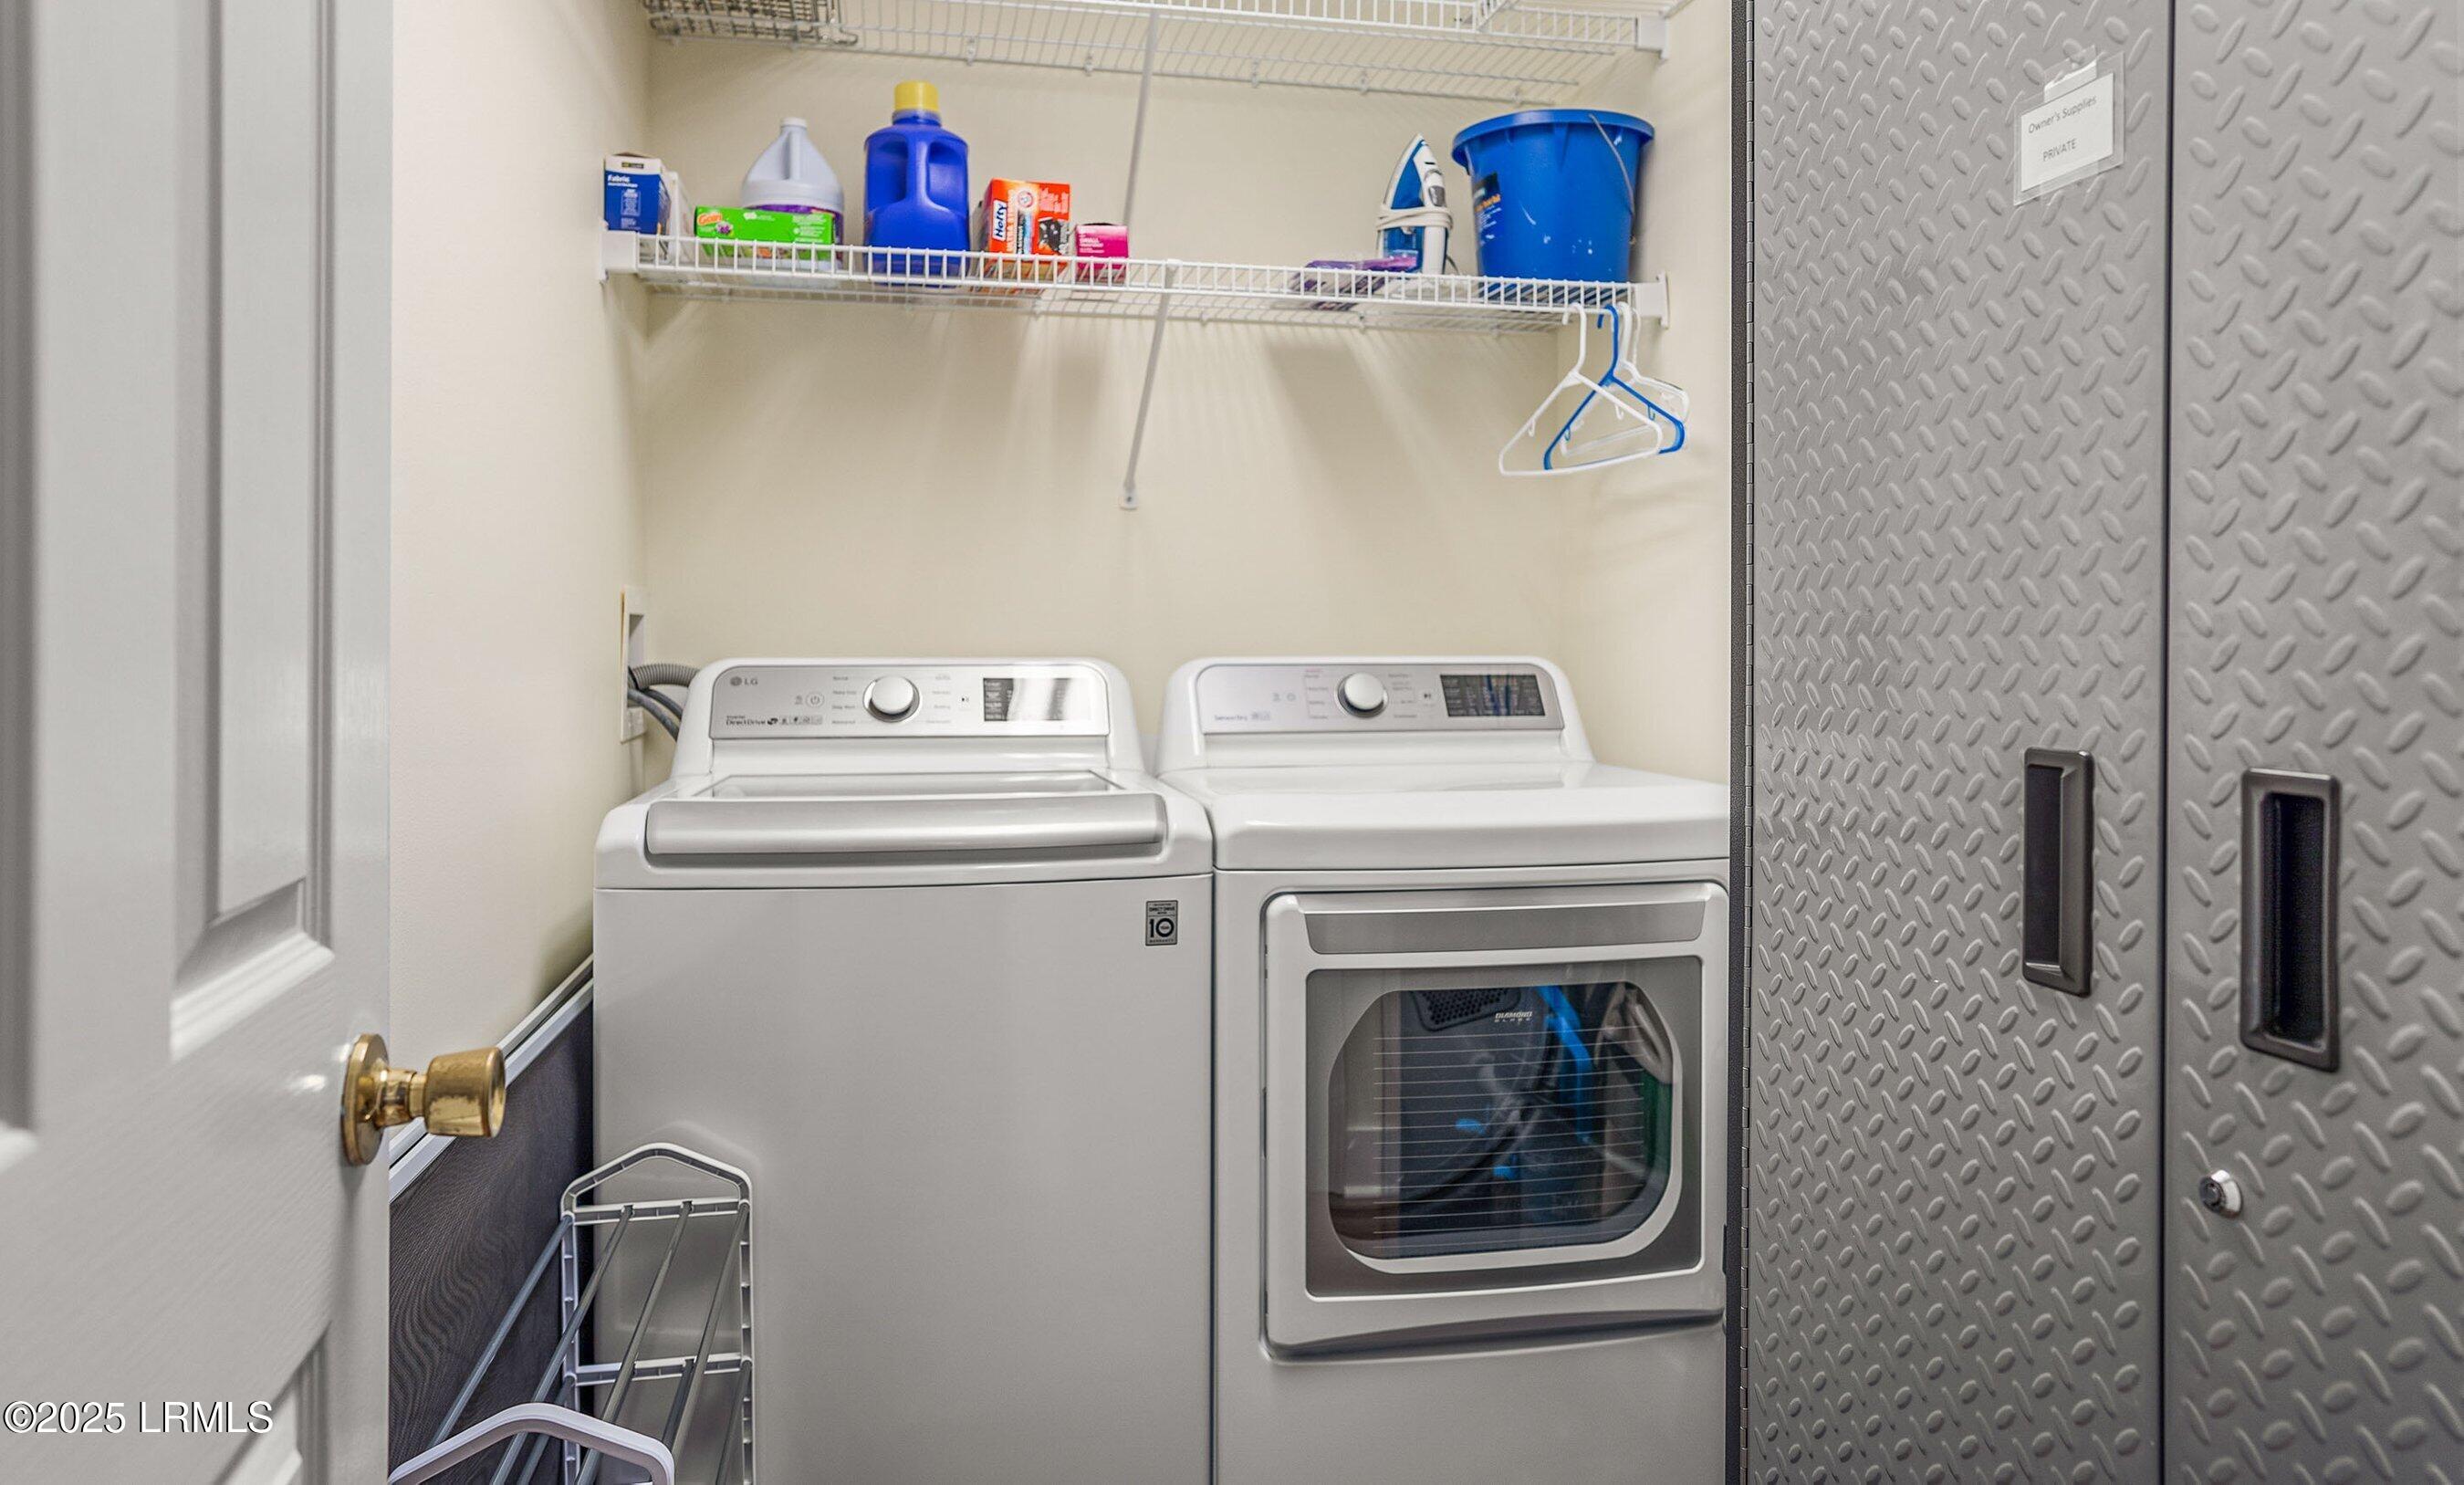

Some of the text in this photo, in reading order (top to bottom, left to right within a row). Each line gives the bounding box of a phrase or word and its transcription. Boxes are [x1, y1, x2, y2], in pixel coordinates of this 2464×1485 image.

[2028, 95, 2098, 134] Owner's Supplies
[2042, 138, 2077, 162] PRIVATE
[995, 203, 1008, 238] Hefty
[744, 677, 758, 685] LG
